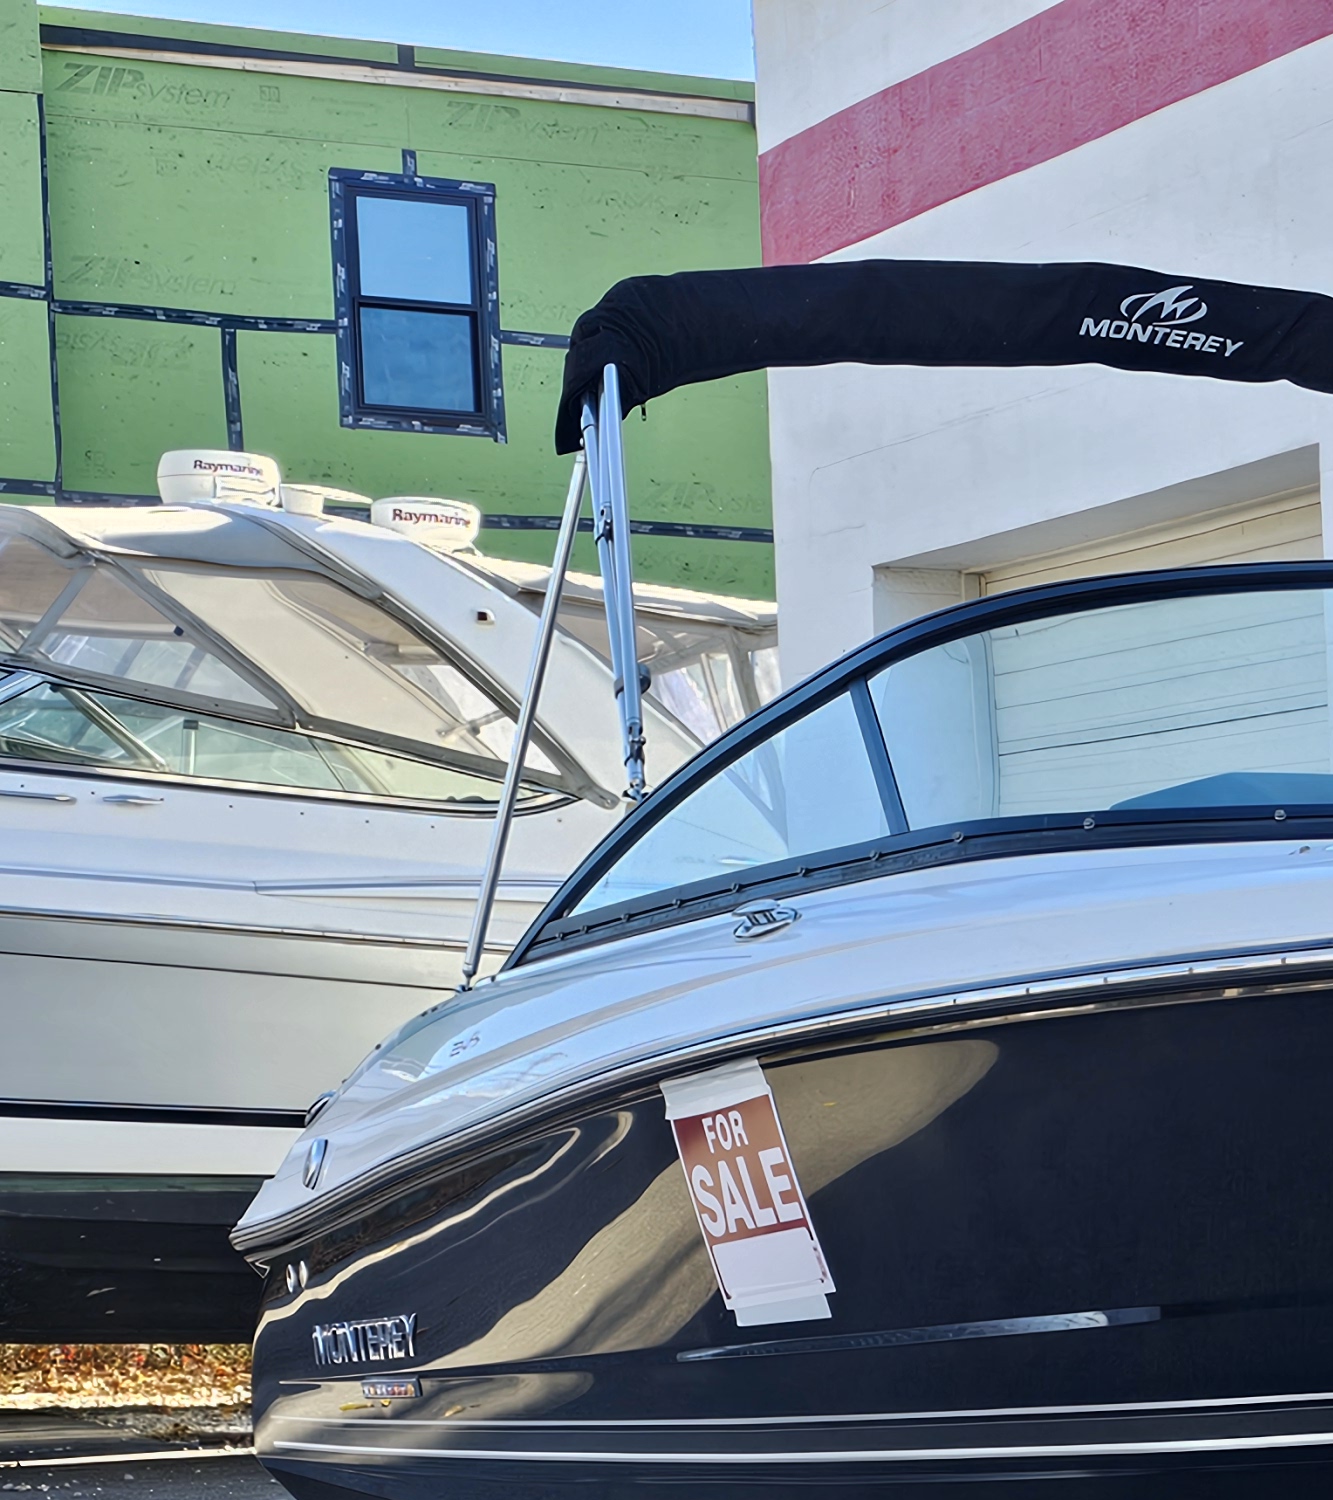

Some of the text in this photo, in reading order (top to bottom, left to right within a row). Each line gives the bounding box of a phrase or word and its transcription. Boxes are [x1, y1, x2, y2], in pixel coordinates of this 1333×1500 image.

[54, 62, 145, 96] ZIP
[135, 81, 231, 109] system
[1078, 316, 1245, 358] MONTEREY
[193, 459, 264, 477] Raymarine
[391, 508, 472, 529] Raymarine
[702, 1109, 749, 1154] FOR
[691, 1146, 804, 1238] SALE
